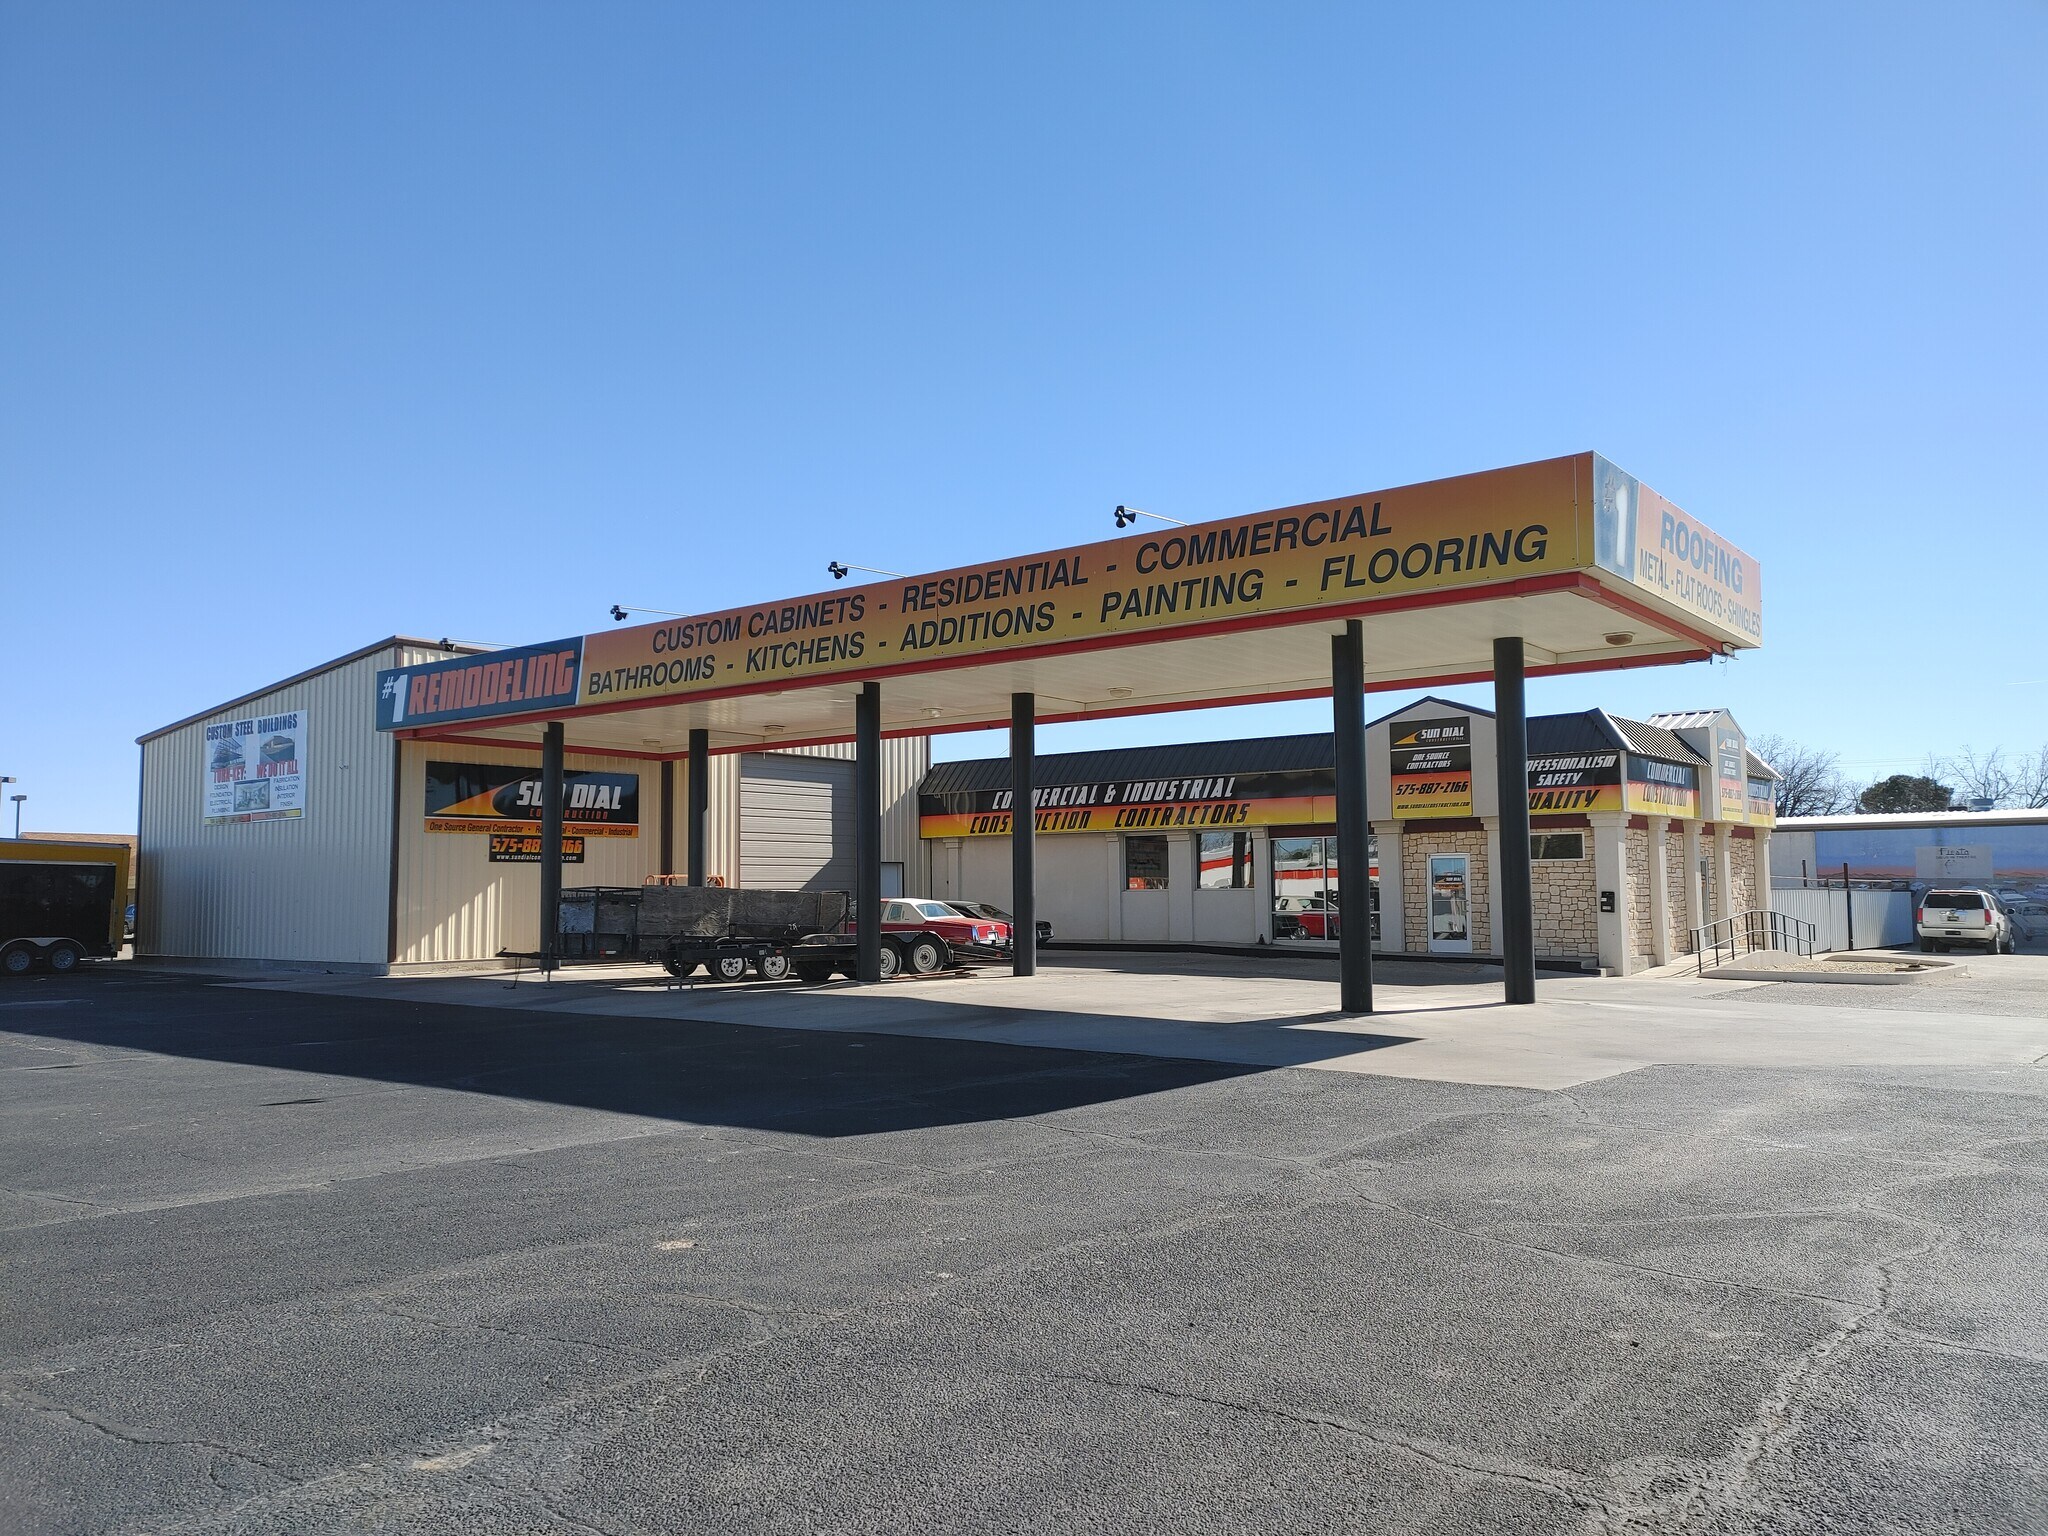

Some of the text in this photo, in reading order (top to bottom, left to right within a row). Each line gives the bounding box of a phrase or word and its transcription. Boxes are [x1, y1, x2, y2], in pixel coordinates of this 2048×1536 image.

[1661, 509, 1743, 595] ROOFING
[652, 615, 742, 653] CUSTOM
[747, 594, 866, 638] CABINETS
[901, 556, 1089, 613] RESIDENTIAL
[1135, 502, 1392, 575] COMMERCIAL
[1639, 548, 1669, 590] METAL
[1675, 568, 1696, 602] FLAT
[1696, 580, 1723, 619] ROOFS
[1727, 598, 1761, 638] SHINGLES
[588, 654, 715, 696] BATHROOMS
[745, 631, 865, 673] KITCHENS
[900, 601, 1055, 652] ADDITIONS
[1100, 568, 1264, 624] PAINTING
[1320, 524, 1550, 592] FLOORING
[382, 650, 575, 723] #1 REMODELING
[206, 713, 298, 741] CUSTOM STEEL BUILDINGS
[1421, 726, 1465, 739] SUN DIAL
[287, 759, 299, 775] ALL
[1406, 760, 1452, 770] CONTRACTORS
[1412, 752, 1451, 761] ONE SOURCE
[1527, 755, 1617, 772] OFESSIONALISM
[1536, 772, 1584, 786] SAFETY
[1647, 761, 1686, 785] COMMERCIAL
[570, 783, 622, 810] DIAL
[992, 777, 1237, 810] COERCIAL & INDUSTRIAL
[1395, 781, 1469, 796] 575-887-2166
[1528, 789, 1600, 810] UALITY
[529, 809, 609, 820] CORUCTION
[970, 803, 1251, 834] CONSUCTION CONTRACTORS
[429, 822, 443, 831] One
[443, 822, 466, 832] Source
[467, 823, 492, 832] General
[492, 823, 524, 833] Contractor
[571, 826, 604, 836] Commercial
[607, 827, 633, 836] Industrial
